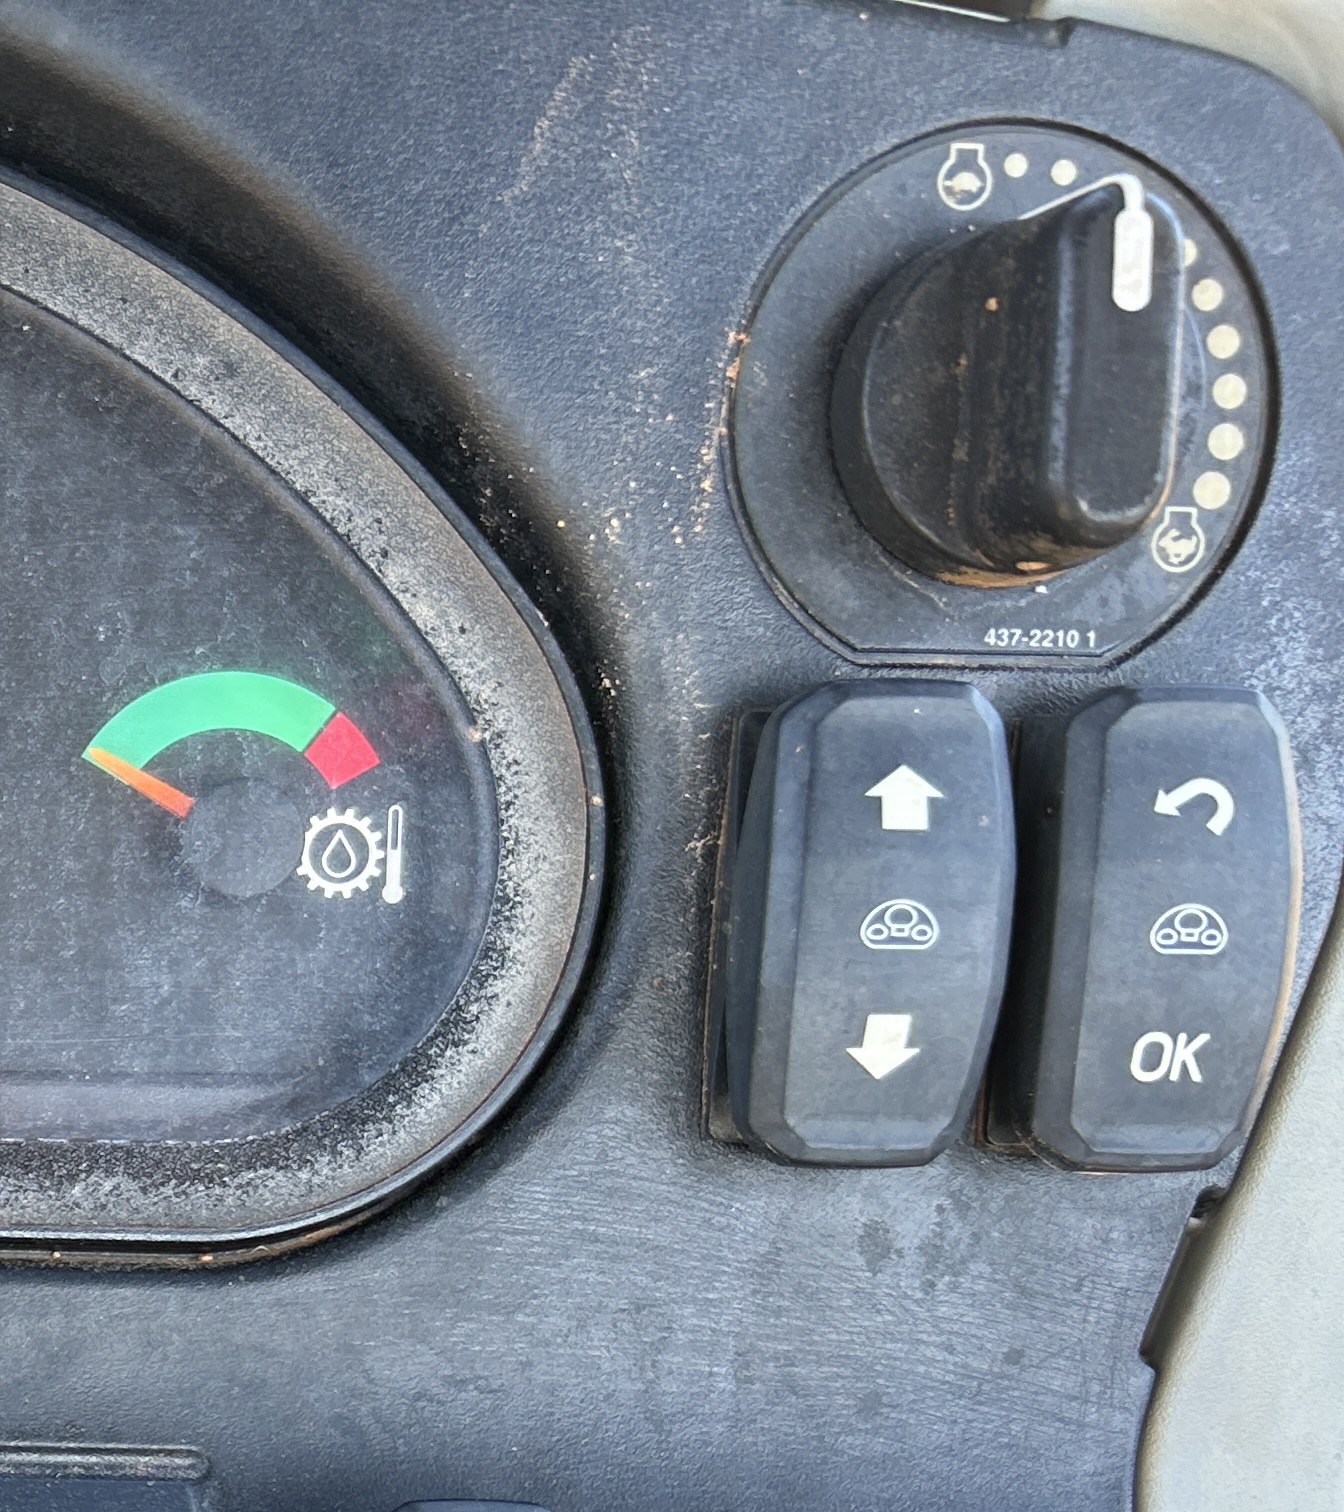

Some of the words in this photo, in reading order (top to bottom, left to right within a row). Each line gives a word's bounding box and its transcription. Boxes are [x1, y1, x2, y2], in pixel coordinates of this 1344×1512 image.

[984, 628, 1080, 648] 437-2210
[1087, 630, 1096, 648] 1
[1130, 1031, 1212, 1083] OK
